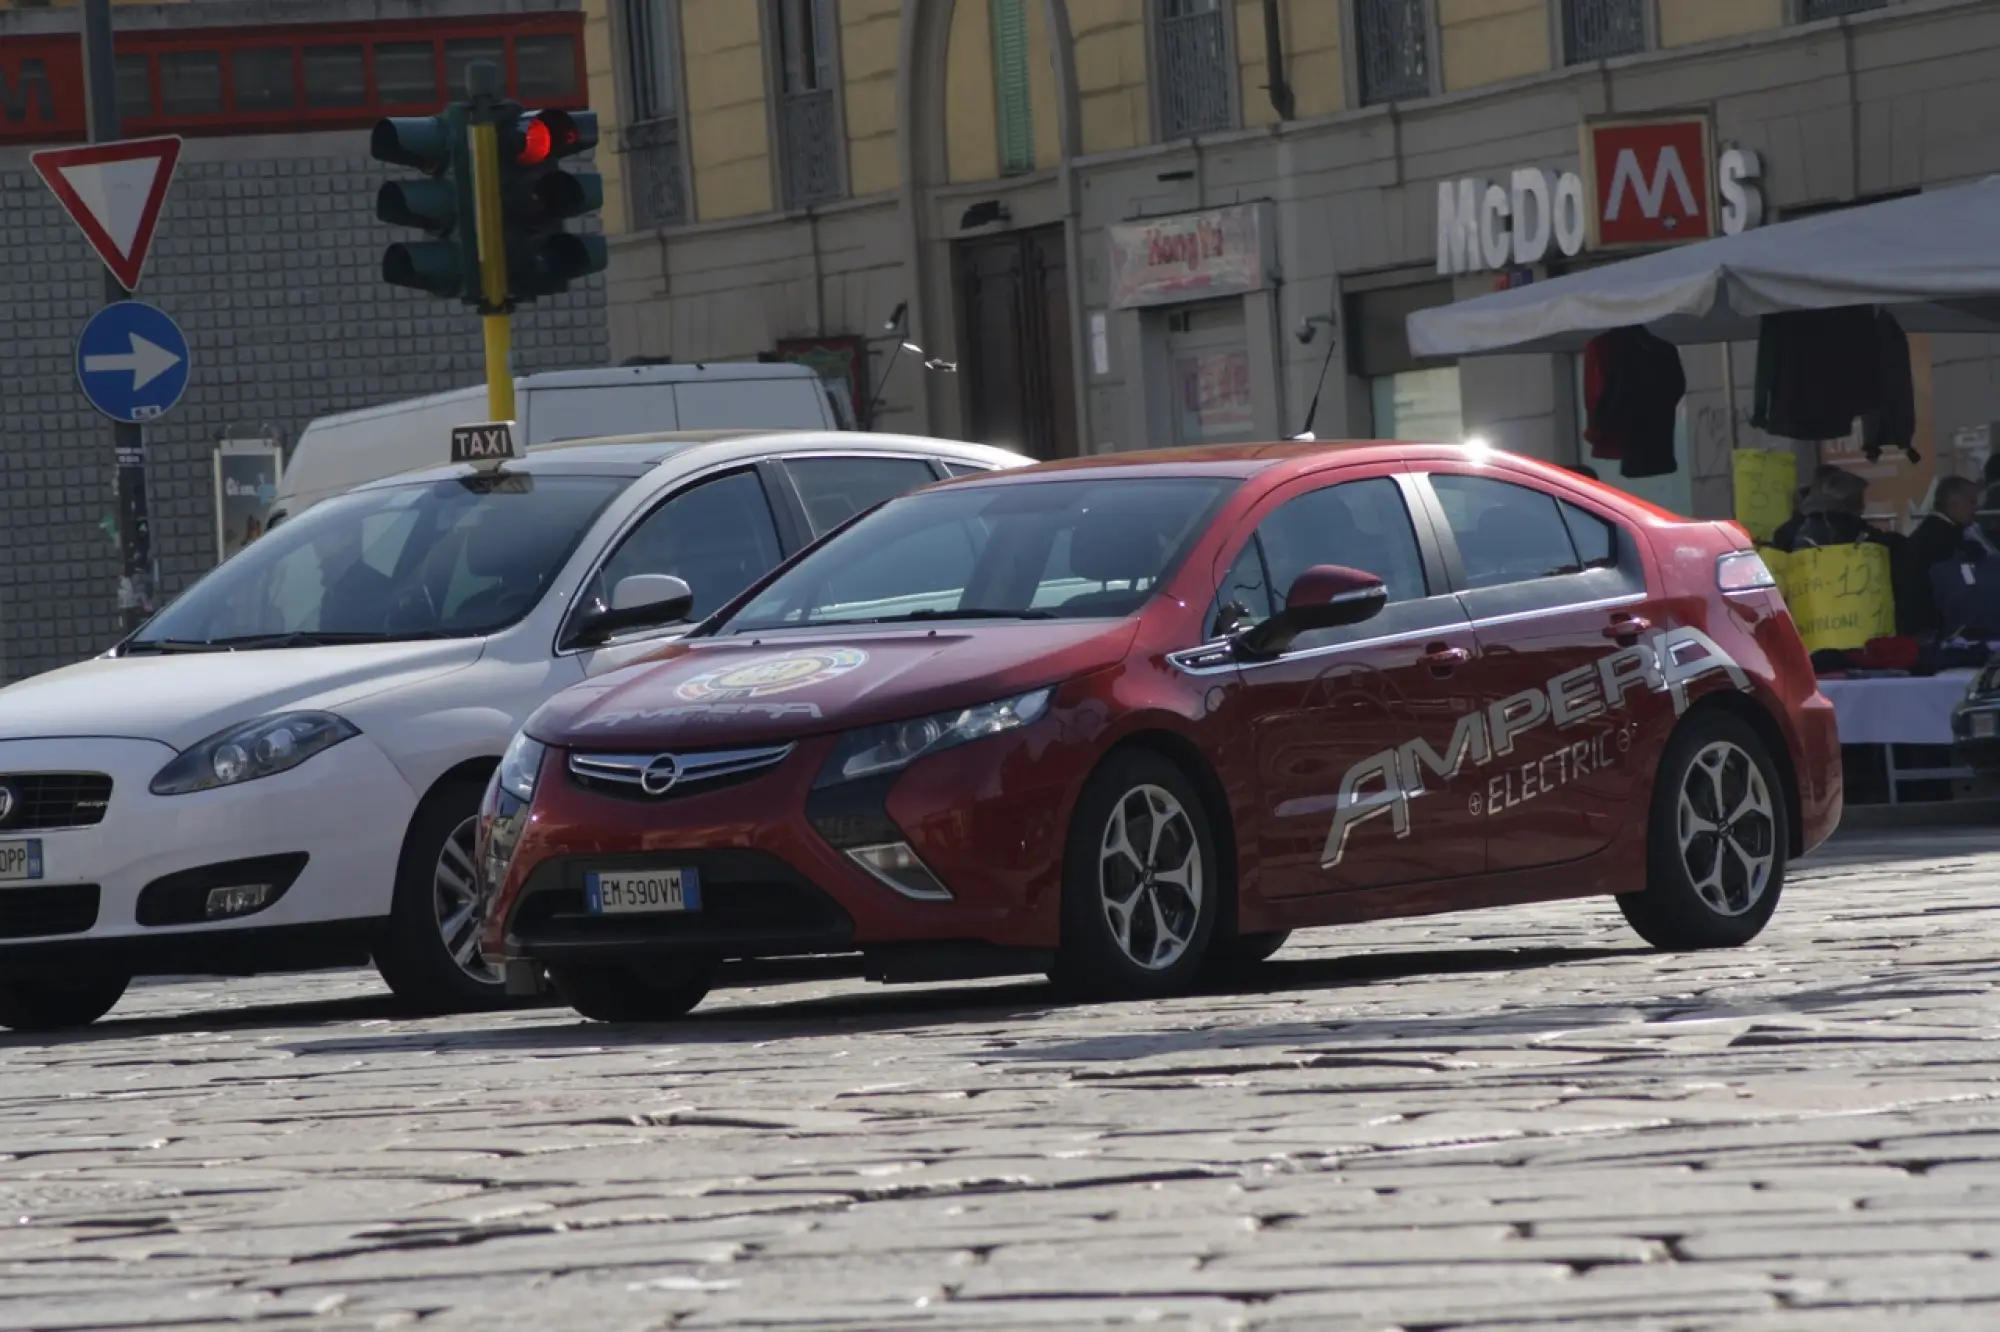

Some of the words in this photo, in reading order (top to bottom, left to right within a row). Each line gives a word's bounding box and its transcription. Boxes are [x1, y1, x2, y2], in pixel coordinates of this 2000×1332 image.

[1604, 145, 1698, 221] M
[454, 430, 508, 457] TAXI
[569, 701, 824, 731] AMPERA
[1320, 626, 1755, 870] AMPERA
[1486, 728, 1615, 816] ELECTRIC
